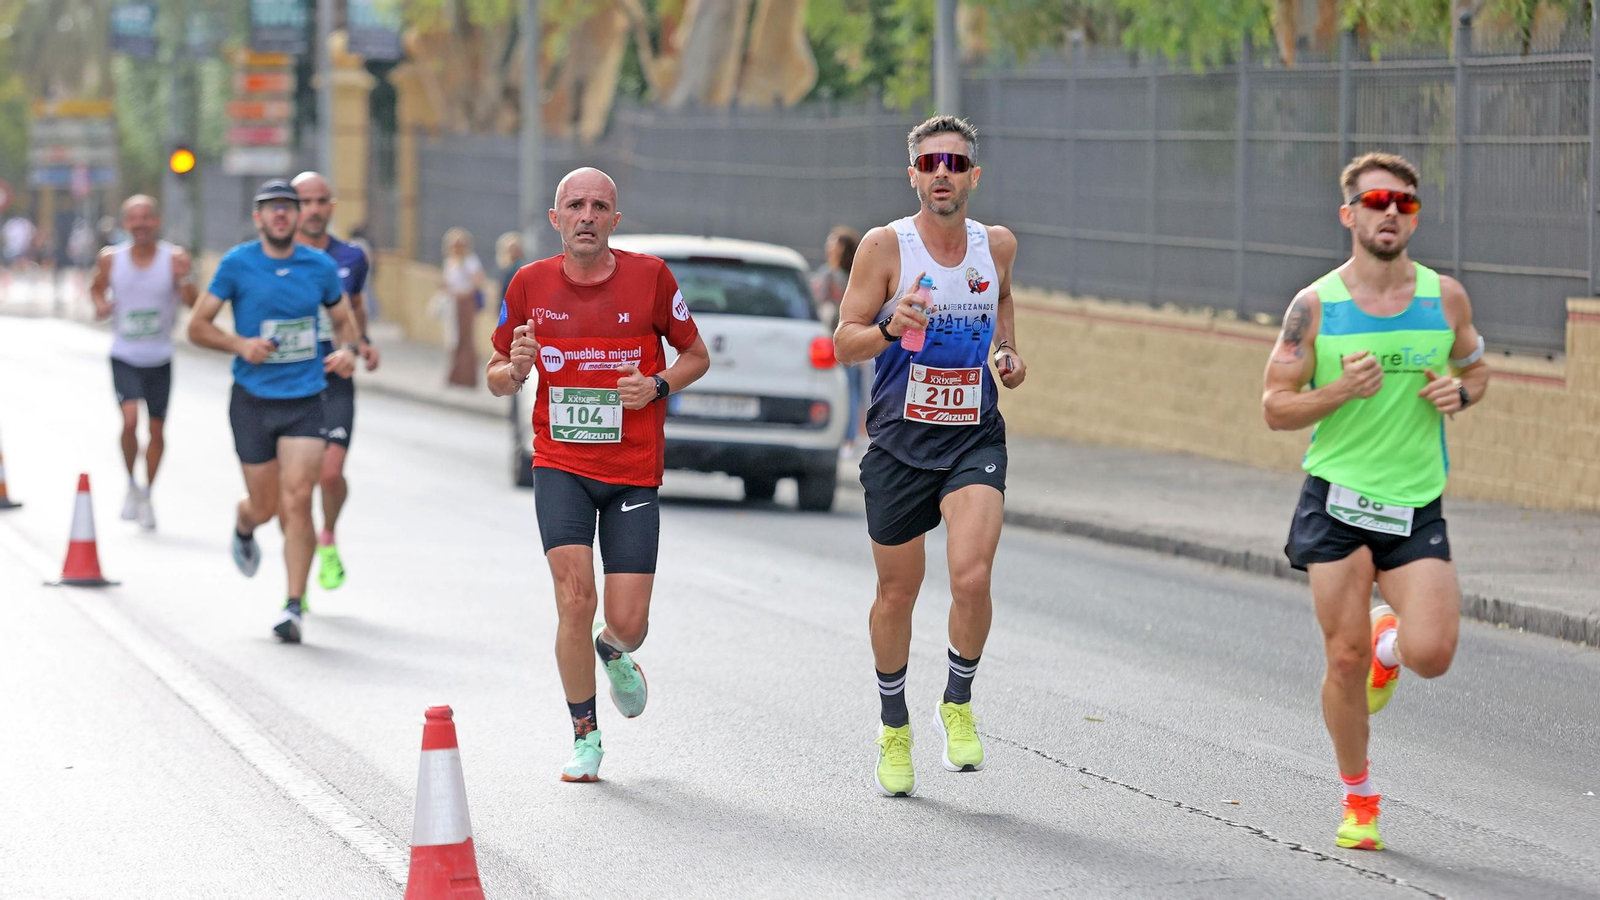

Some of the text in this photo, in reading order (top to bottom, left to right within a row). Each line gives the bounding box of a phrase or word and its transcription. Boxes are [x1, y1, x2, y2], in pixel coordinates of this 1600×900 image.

[542, 354, 561, 364] mm
[564, 345, 642, 362] muebles miguel
[925, 386, 964, 406] 210
[566, 406, 603, 425] 104
[932, 411, 975, 421] MIZUNO
[573, 430, 615, 440] MIZUNO
